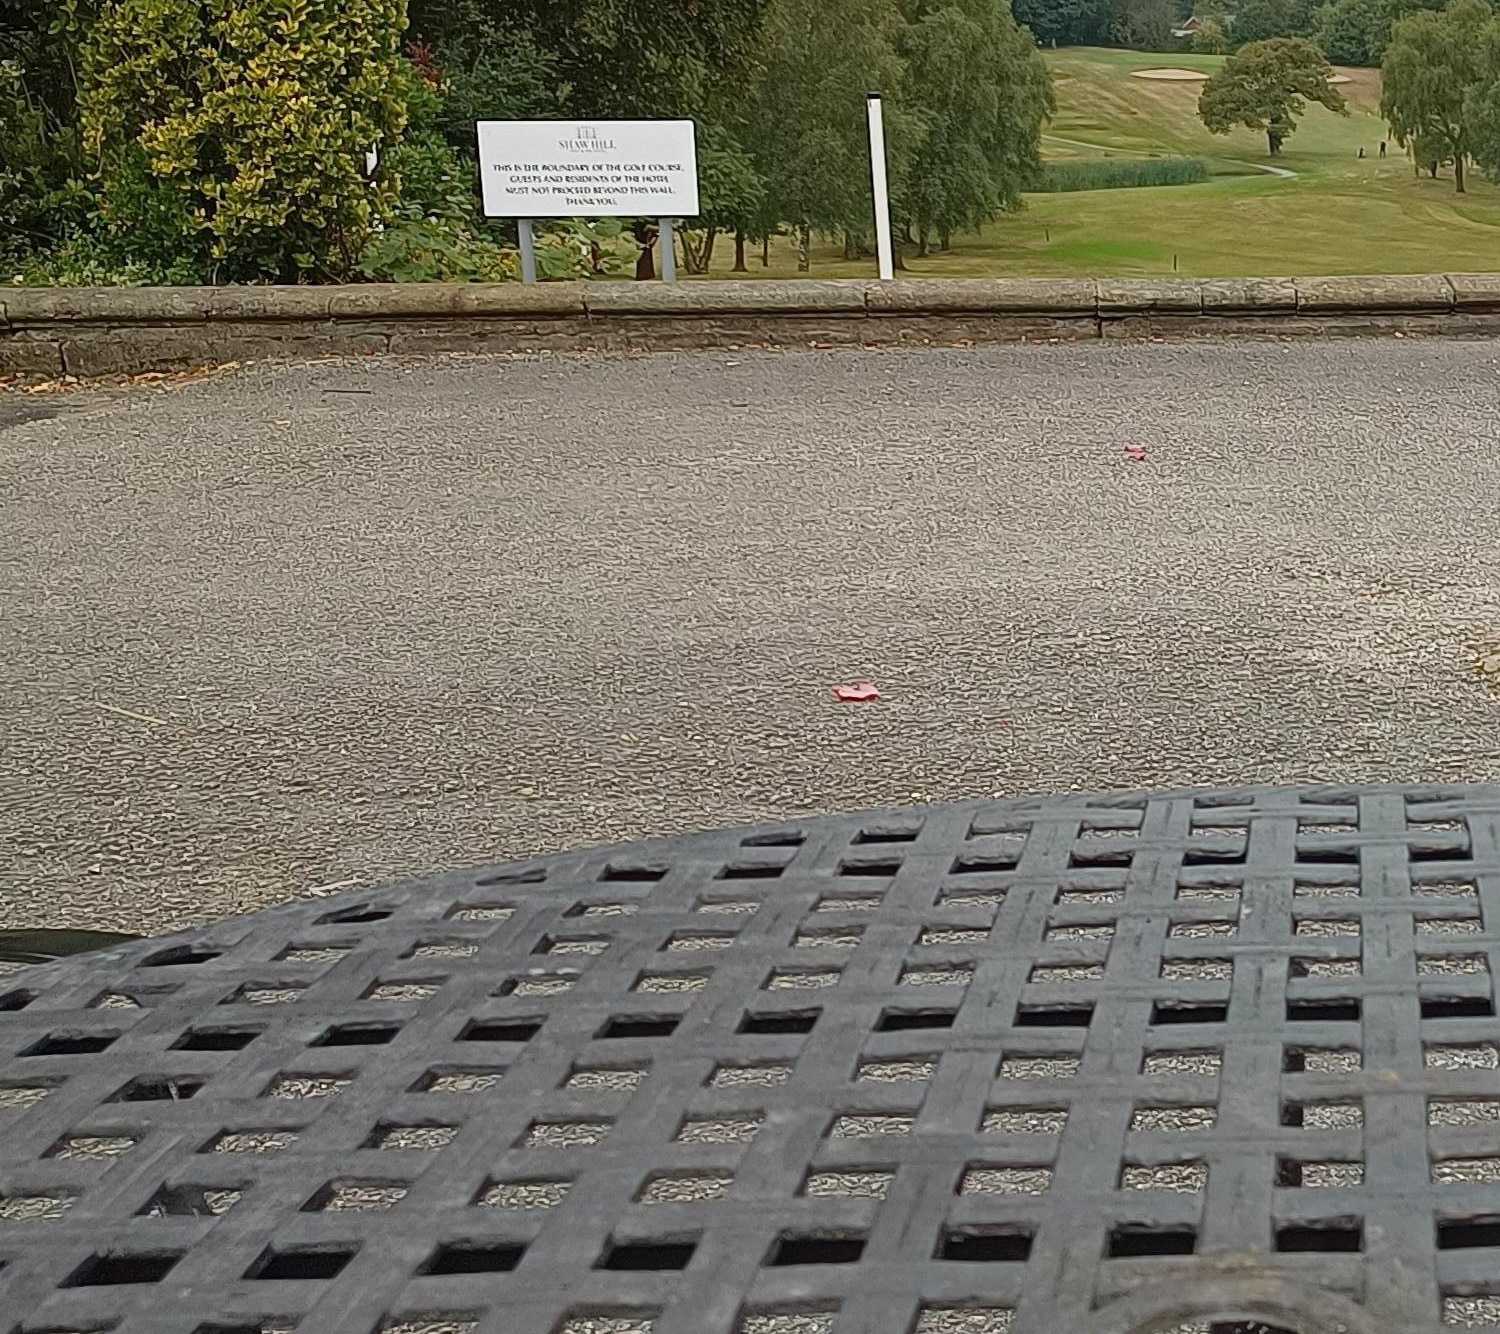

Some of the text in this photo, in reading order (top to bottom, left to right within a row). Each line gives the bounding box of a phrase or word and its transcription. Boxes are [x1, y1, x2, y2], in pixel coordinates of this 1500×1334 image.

[544, 175, 563, 183] AND
[611, 175, 622, 183] OF
[624, 175, 640, 183] THE
